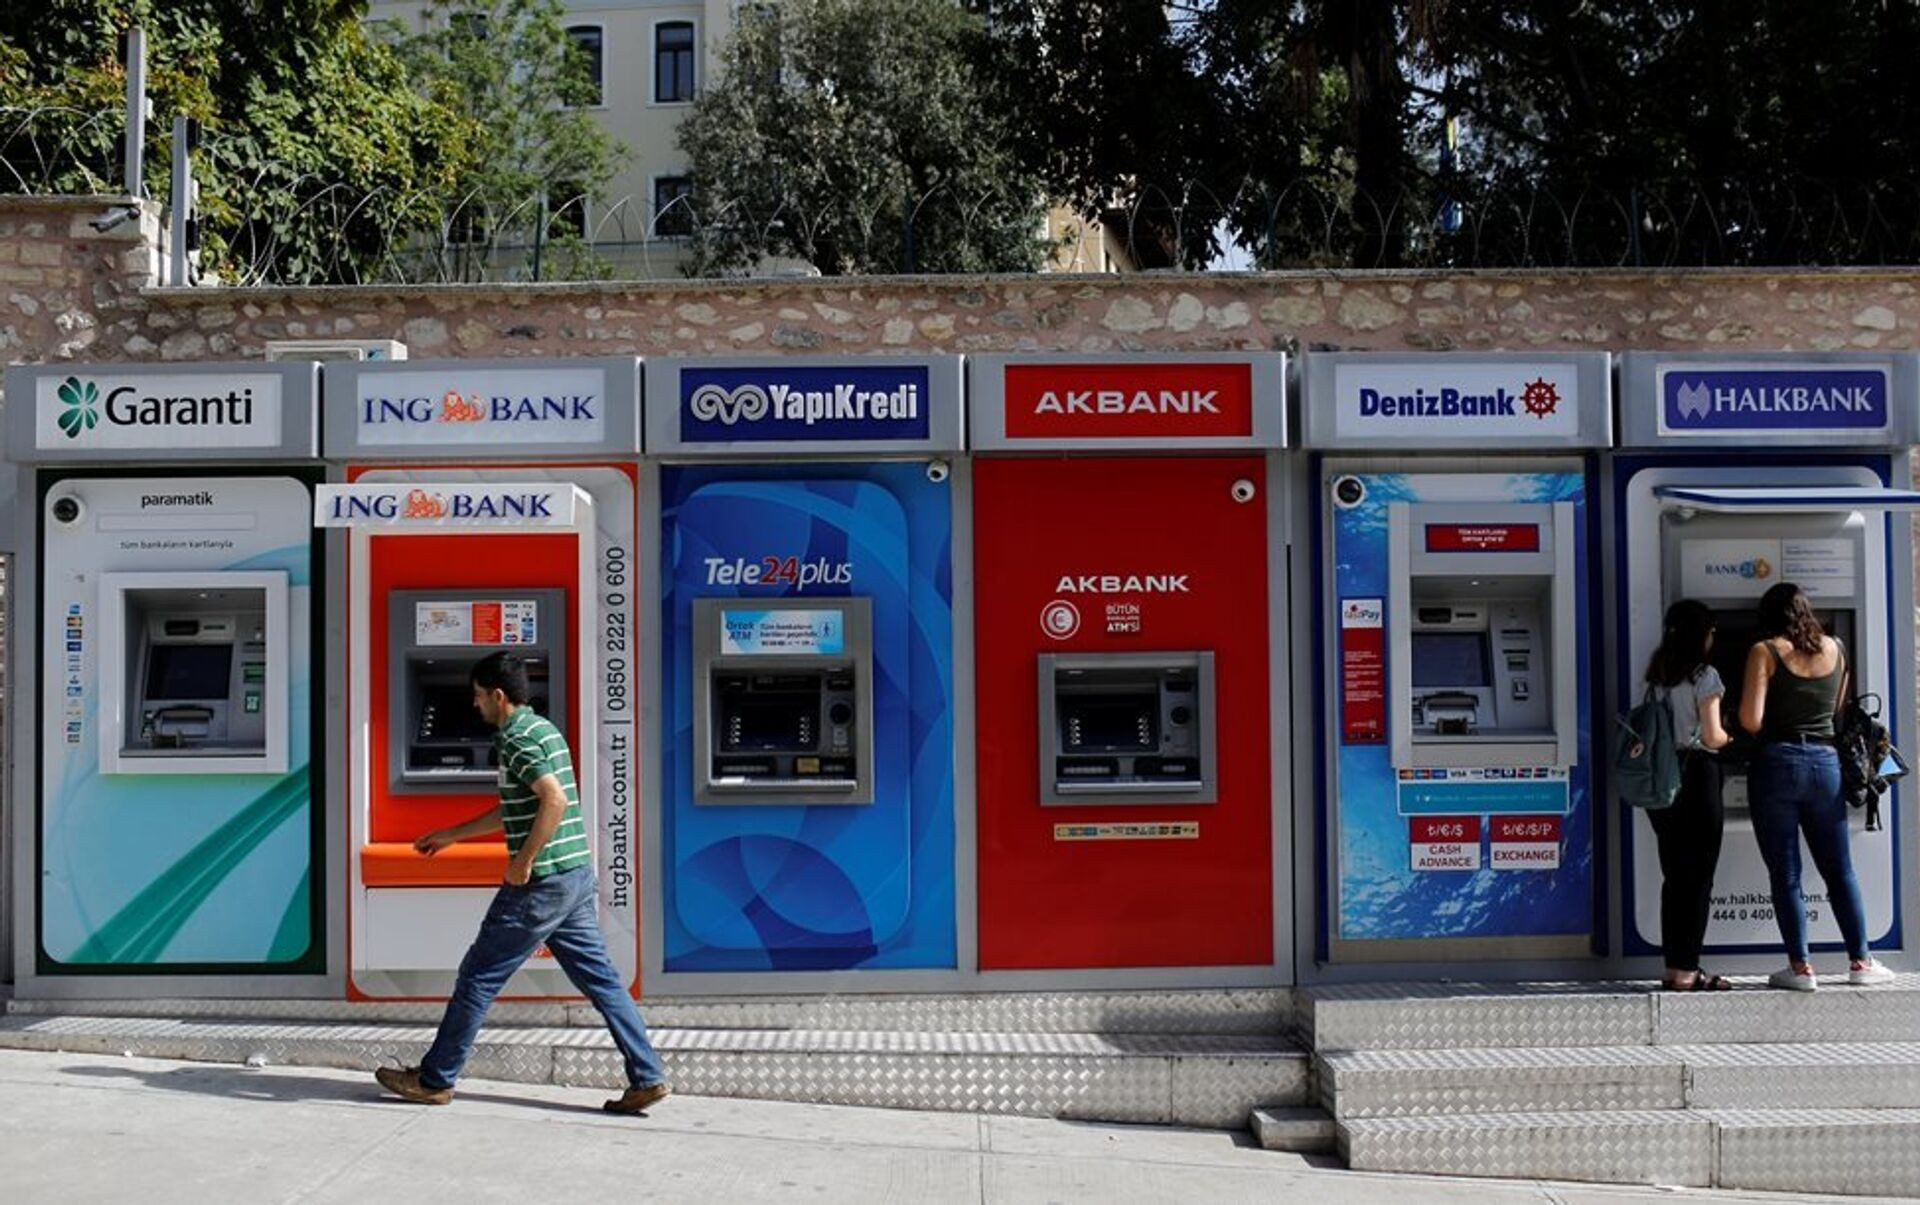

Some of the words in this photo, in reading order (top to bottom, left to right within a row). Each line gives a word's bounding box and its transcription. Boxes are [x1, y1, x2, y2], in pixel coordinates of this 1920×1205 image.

[104, 386, 252, 426] Garanti
[363, 398, 433, 424] ING
[490, 395, 596, 421] BANK
[768, 384, 917, 425] YapıKredi
[1034, 390, 1220, 414] AKBANK
[1359, 388, 1516, 417] DenizBank
[1714, 387, 1873, 412] HALKBANK
[141, 492, 214, 508] paramatik
[332, 495, 398, 518] ING
[452, 494, 552, 518] BANK
[606, 546, 625, 587] 600
[704, 556, 853, 592] Tele24plus
[1055, 575, 1190, 593] AKBANK
[606, 592, 625, 607] 0
[606, 612, 625, 652] 222
[606, 658, 626, 712] 0850
[608, 734, 632, 908] ingbank.com.tr
[1418, 857, 1472, 867] ADVANCE
[1428, 845, 1462, 855] CASH
[1493, 850, 1556, 861] EXCHANGE
[1713, 909, 1736, 920] 444
[1751, 908, 1774, 920] 400
